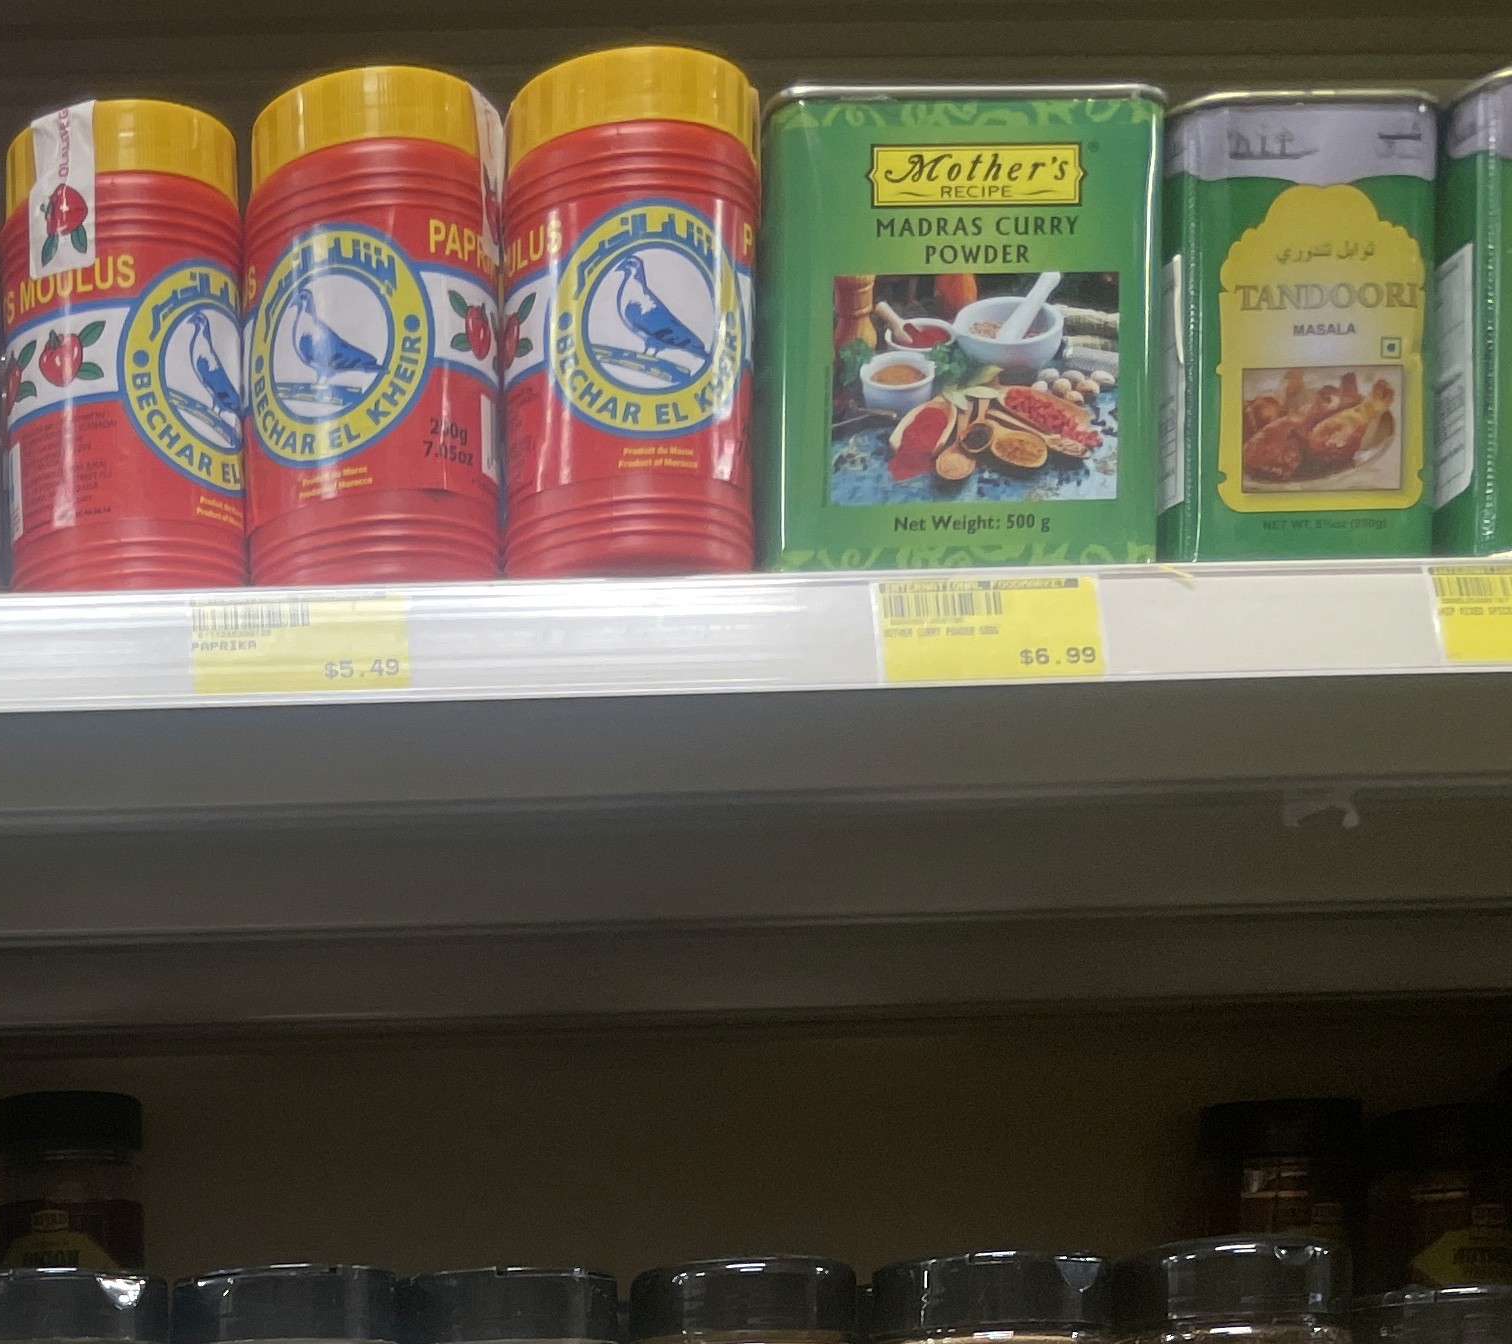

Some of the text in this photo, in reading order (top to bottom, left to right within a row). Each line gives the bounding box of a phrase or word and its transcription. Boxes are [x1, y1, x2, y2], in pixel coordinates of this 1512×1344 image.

[884, 153, 1069, 188] Mother's
[940, 185, 1013, 200] RECIPE
[876, 214, 1079, 238] MADRAS CURRY
[924, 243, 1030, 266] POWDER
[1234, 281, 1420, 311] TANDOORI
[1293, 321, 1357, 338] MASALA
[252, 329, 424, 456] BECHAR EL KHEIR
[894, 514, 1051, 535] Net Weight: 500 g
[1019, 646, 1097, 668] $6.99
[324, 658, 400, 679] $5.49
